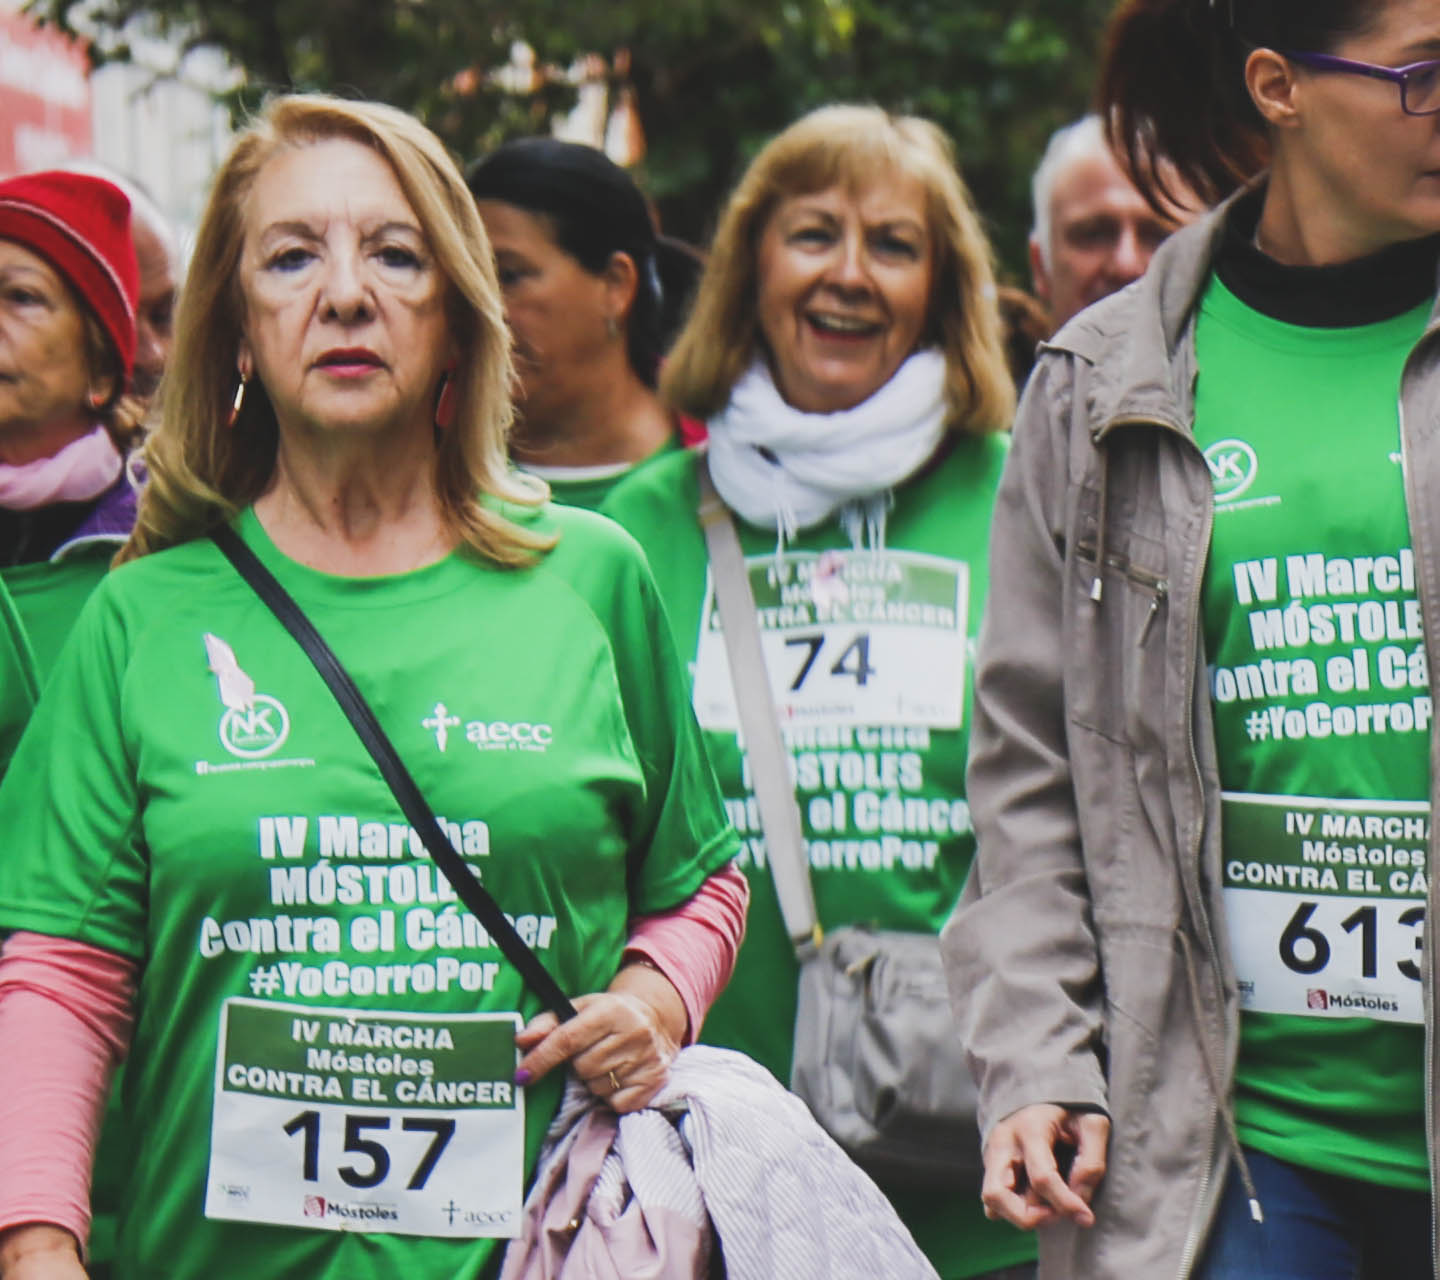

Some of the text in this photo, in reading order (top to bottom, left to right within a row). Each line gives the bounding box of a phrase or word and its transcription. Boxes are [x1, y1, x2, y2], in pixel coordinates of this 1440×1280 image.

[1233, 558, 1277, 604] IV
[1249, 600, 1424, 650] MÓSTOLE
[785, 632, 876, 691] 74
[1213, 658, 1319, 703] ontra
[1327, 649, 1370, 696] el
[466, 721, 552, 744] aecc
[1246, 696, 1432, 742] #YoCorroP
[810, 791, 846, 833] el
[854, 790, 974, 836] Cánce
[1286, 812, 1431, 839] IV MARCH
[259, 816, 307, 859] IV
[1303, 841, 1425, 865] Móstoles
[270, 859, 482, 905] MÓSTOL
[1227, 861, 1338, 889] CONTRA
[1347, 870, 1381, 891] EL
[200, 905, 558, 958] Contra el Cáner
[249, 957, 499, 997] #YoCorroPor
[1330, 994, 1398, 1011] Móstoles
[292, 1019, 454, 1050] IV MARCHA
[307, 1049, 434, 1076] Móstoles
[227, 1064, 511, 1103] CONTRA EL CÁNCER
[283, 1110, 456, 1190] 157
[327, 1203, 398, 1221] Móstoles
